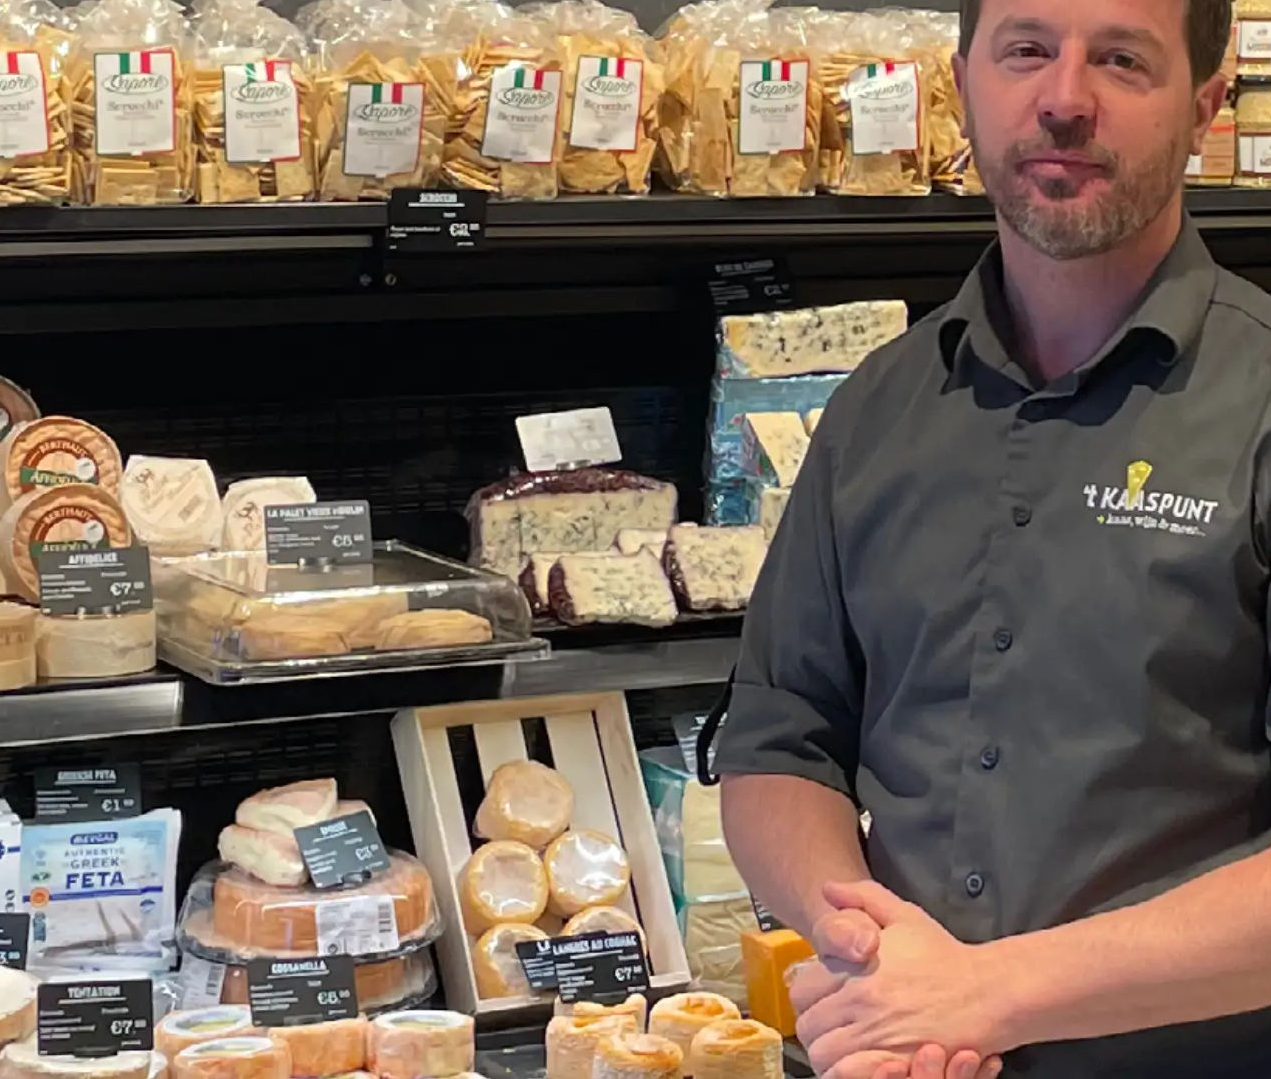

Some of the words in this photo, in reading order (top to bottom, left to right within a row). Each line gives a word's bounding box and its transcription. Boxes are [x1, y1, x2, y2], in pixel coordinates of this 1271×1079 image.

[1100, 485, 1219, 524] KAASPUNT
[70, 857, 121, 870] GREEK
[65, 870, 125, 890] FETA
